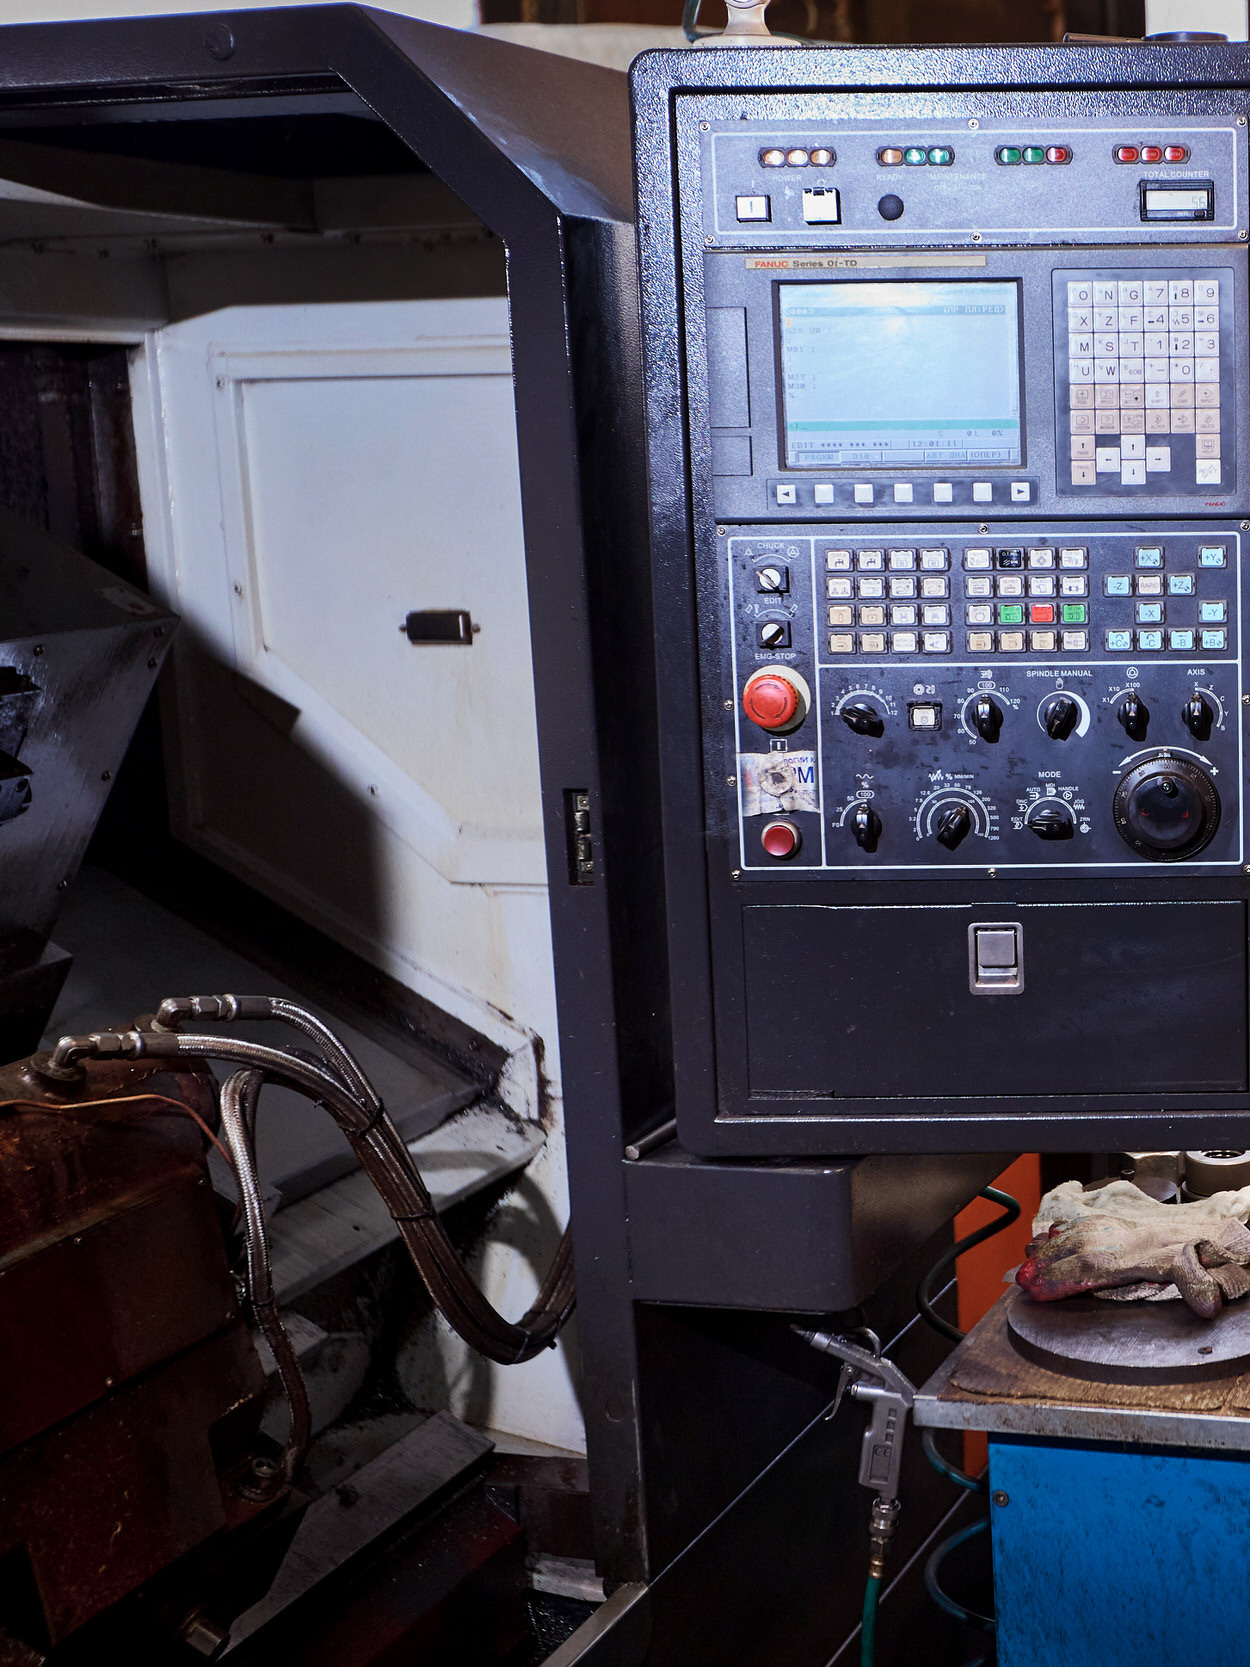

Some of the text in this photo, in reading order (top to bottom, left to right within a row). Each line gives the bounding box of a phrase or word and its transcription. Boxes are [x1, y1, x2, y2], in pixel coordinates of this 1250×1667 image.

[1170, 170, 1209, 178] COUNTER
[1104, 290, 1113, 300] N
[1129, 290, 1138, 300] G
[1156, 288, 1164, 298] 7
[1181, 288, 1189, 298] 8
[1206, 288, 1215, 298] 9
[1080, 316, 1088, 326] X
[1105, 316, 1113, 326] Z
[1130, 316, 1138, 325] F
[1156, 314, 1164, 323] 4
[1181, 314, 1190, 323] 5
[1207, 314, 1215, 323] 6
[1080, 342, 1089, 352] M
[1105, 341, 1114, 351] S
[1130, 341, 1139, 351] T
[1157, 340, 1162, 349] 1
[1182, 340, 1190, 349] 2
[1207, 339, 1216, 349] 3
[1081, 366, 1090, 376] U
[1105, 366, 1116, 376] W
[1113, 582, 1122, 591] -Z
[1173, 581, 1184, 590] +Z
[1145, 610, 1155, 618] -X
[1208, 609, 1217, 617] -Y
[1145, 639, 1155, 647] -C
[1177, 639, 1186, 647] -B
[1204, 639, 1216, 647] +B
